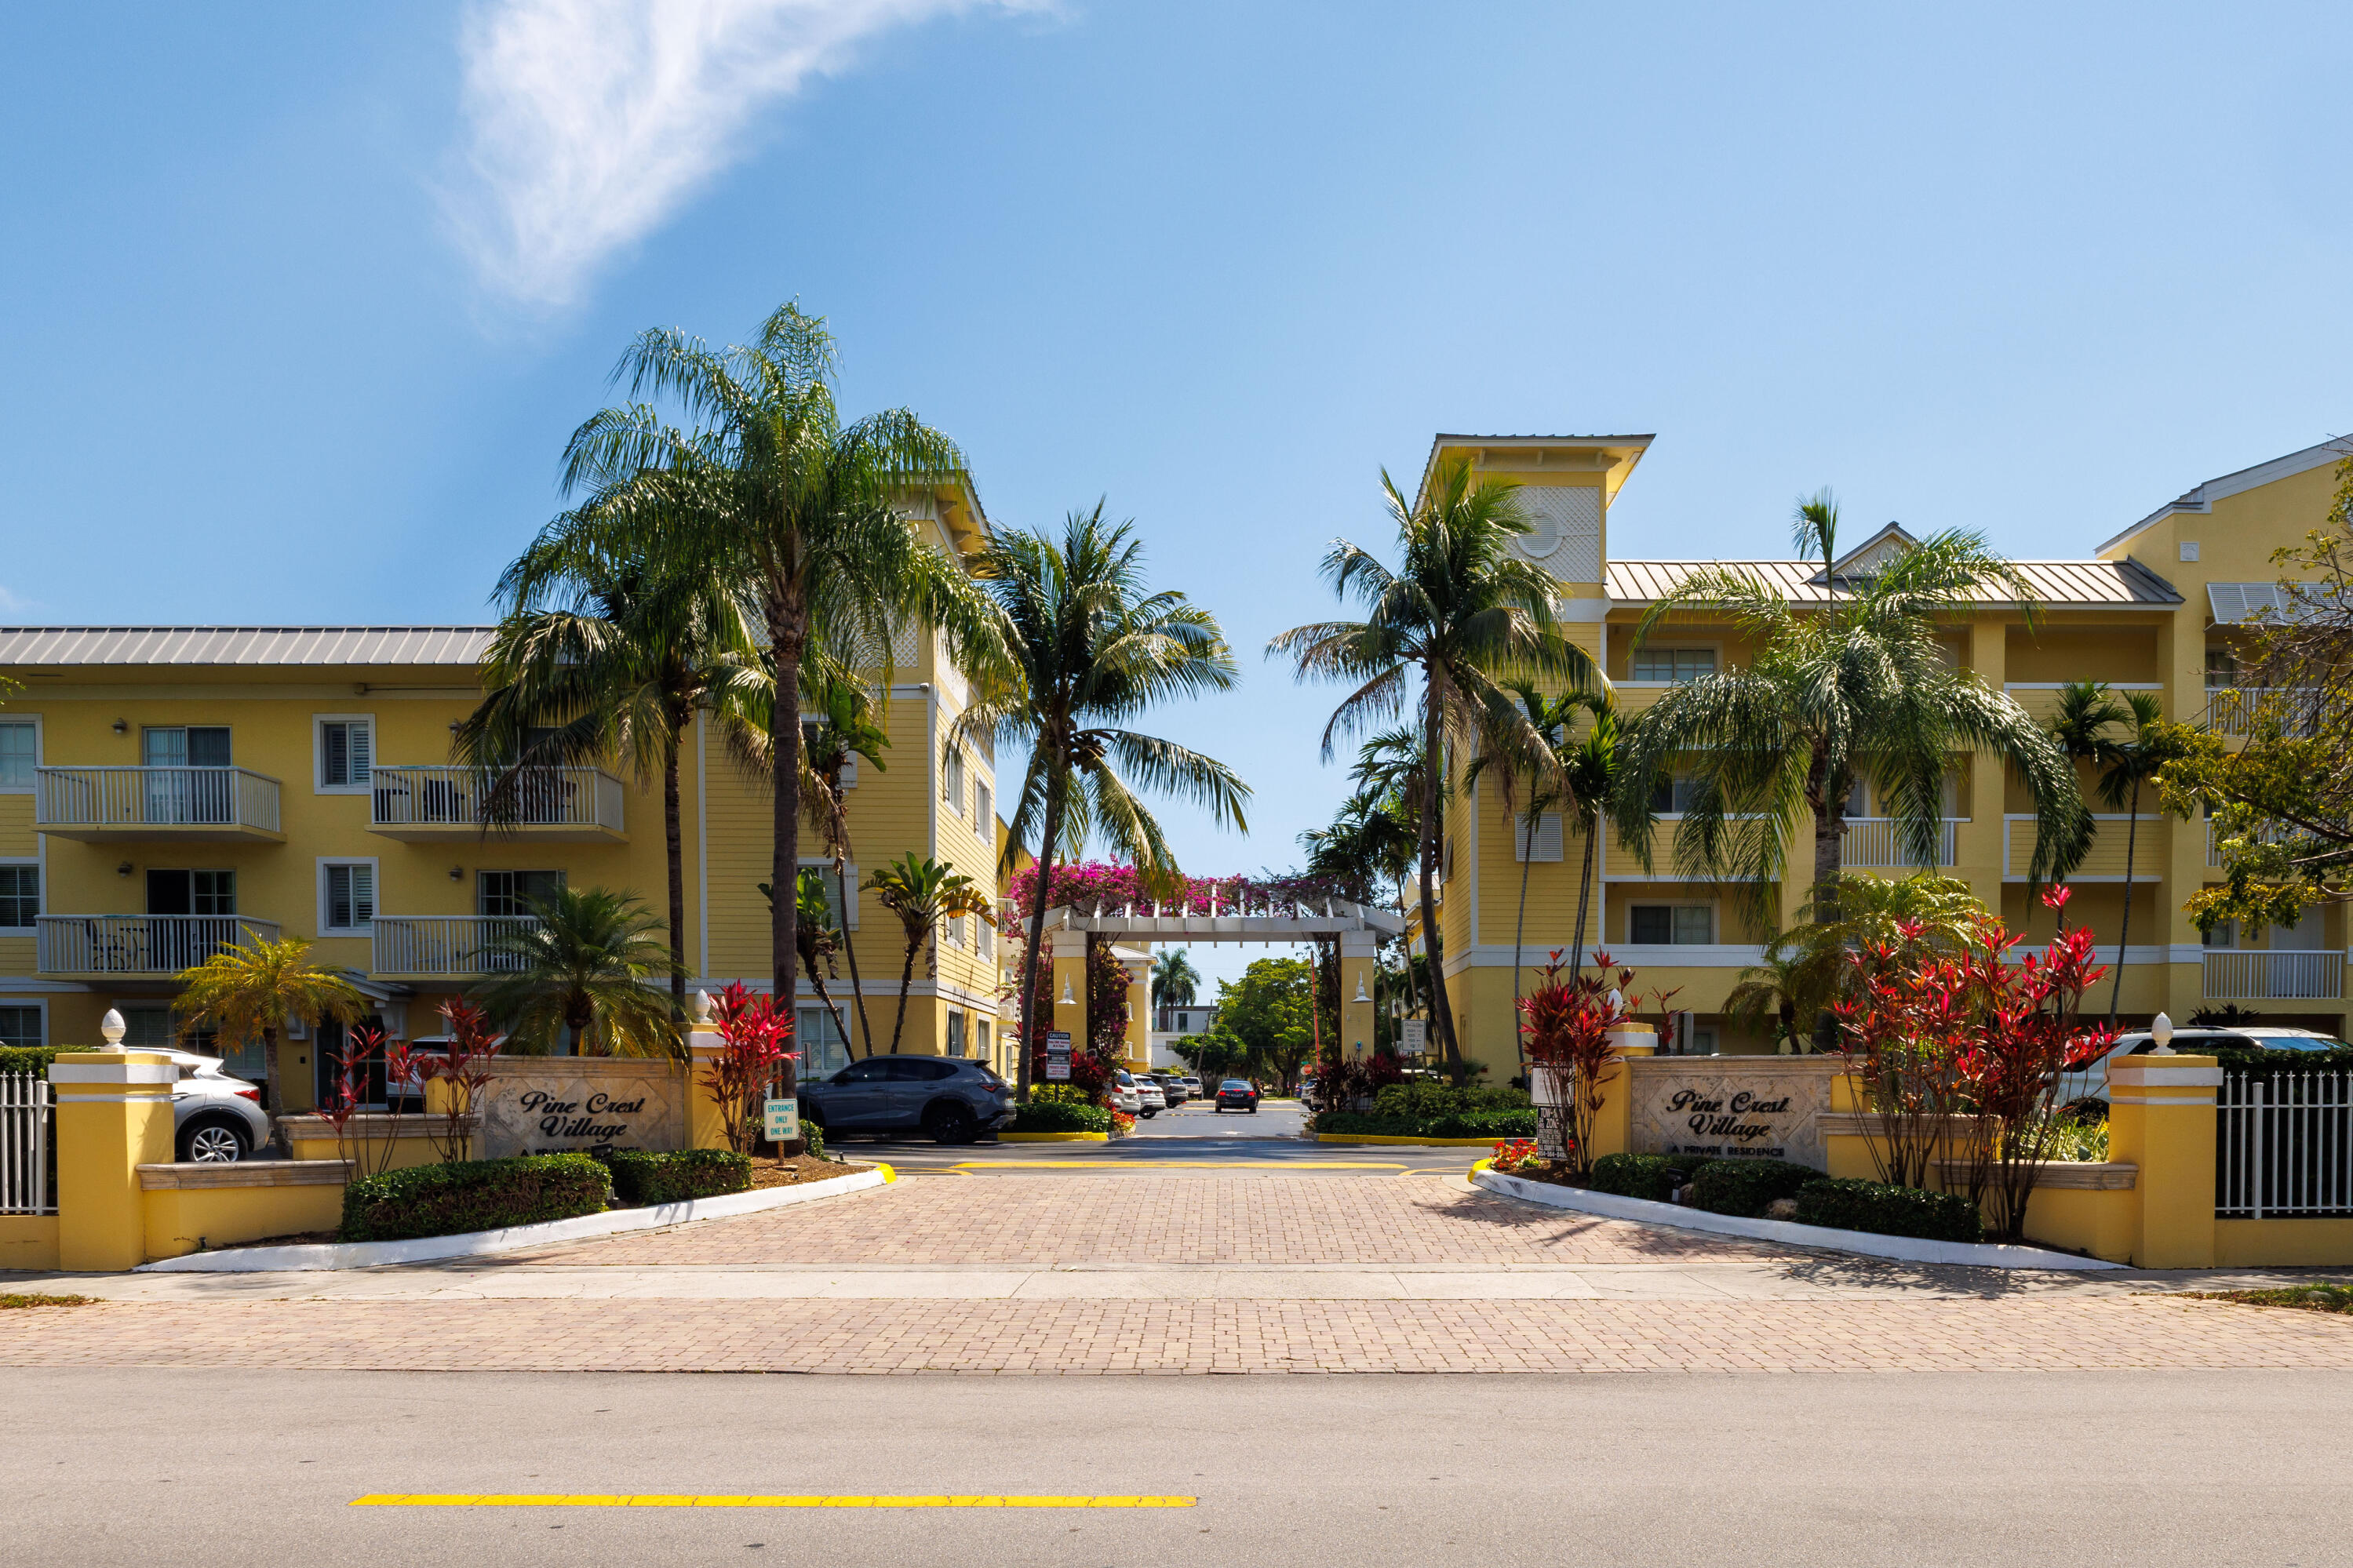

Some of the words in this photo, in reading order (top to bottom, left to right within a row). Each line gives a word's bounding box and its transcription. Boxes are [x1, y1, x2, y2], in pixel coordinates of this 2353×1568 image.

[520, 1091, 577, 1114] Pine
[586, 1093, 646, 1114] Crest
[767, 1104, 794, 1113] ENTRANCE
[1666, 1090, 1723, 1112] Pine
[1730, 1091, 1790, 1113] Crest
[775, 1115, 788, 1124] ONLY
[1688, 1114, 1770, 1142] Village
[539, 1115, 628, 1143] Village
[770, 1127, 781, 1136] ONE
[1671, 1145, 1680, 1154] A
[1684, 1145, 1722, 1155] PRIVATE
[1727, 1146, 1785, 1157] RESIDENCE
